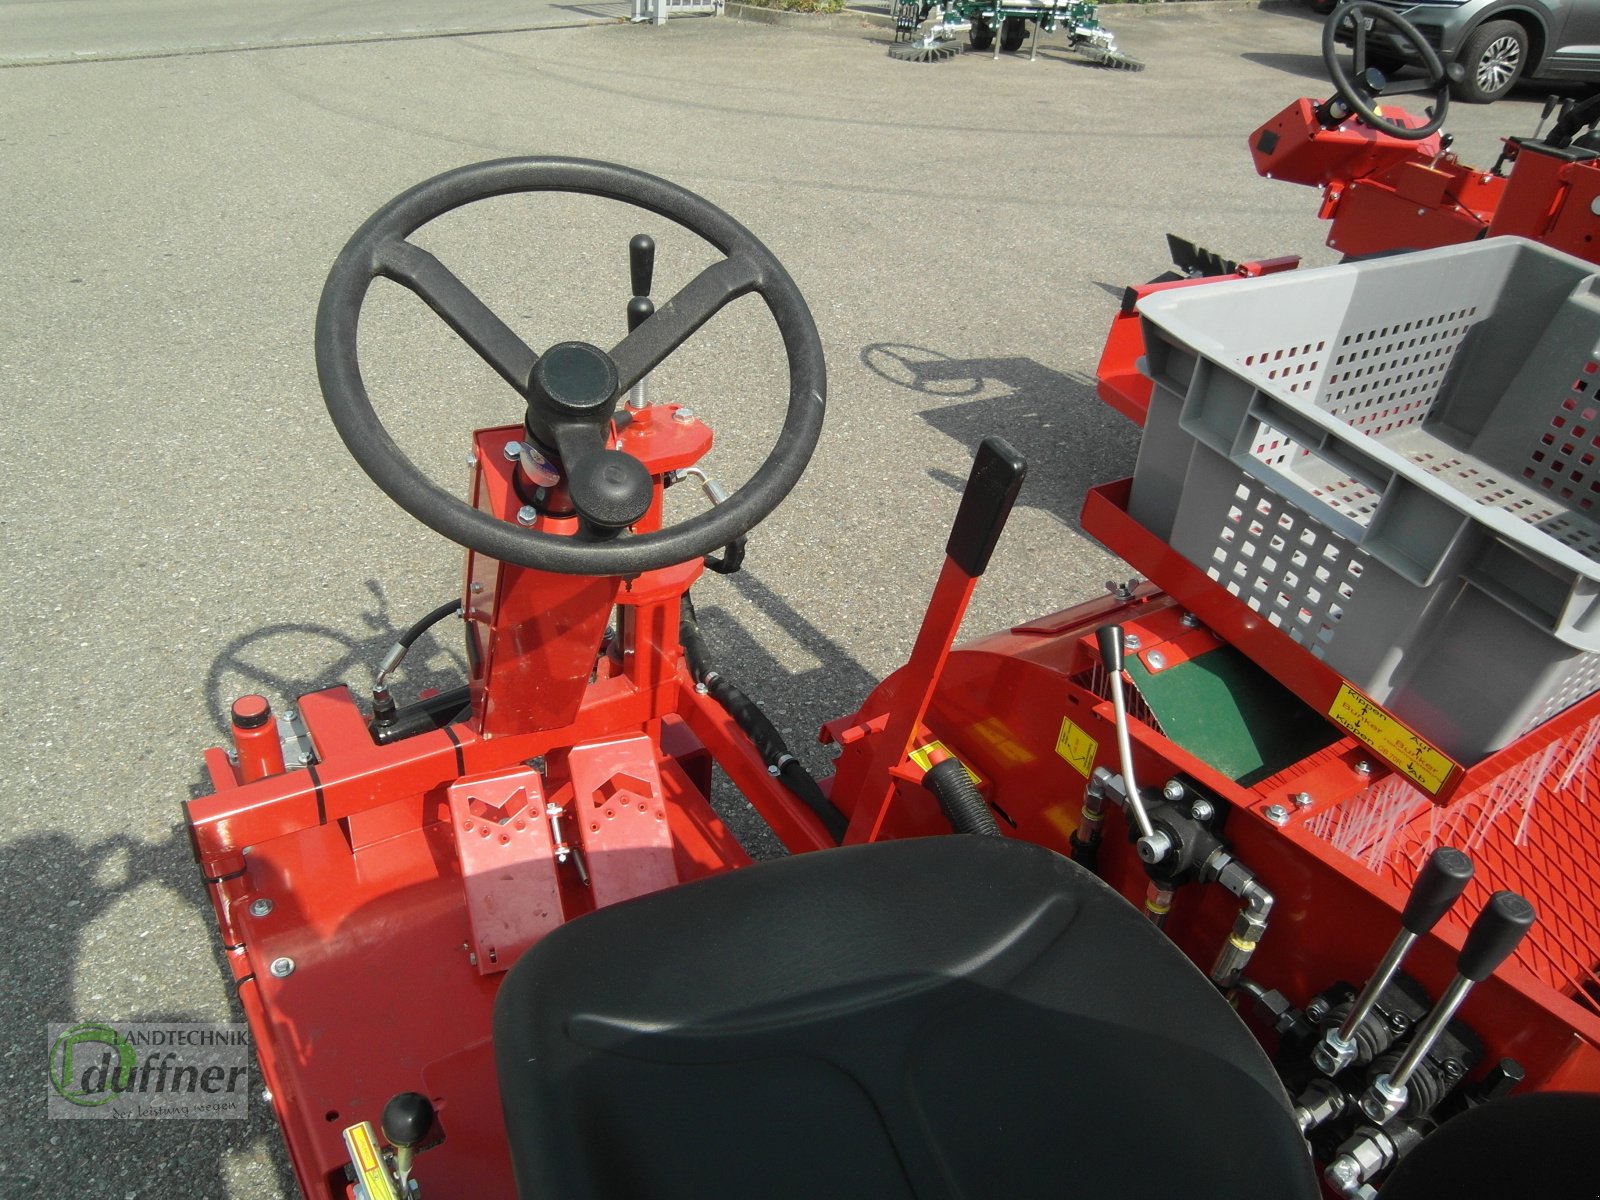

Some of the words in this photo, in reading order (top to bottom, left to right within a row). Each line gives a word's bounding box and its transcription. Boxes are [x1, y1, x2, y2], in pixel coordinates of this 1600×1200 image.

[1342, 702, 1382, 733] Bunker
[1347, 689, 1387, 721] Kippen
[1335, 713, 1374, 746] Kippen
[1409, 736, 1431, 753] Auf
[1394, 739, 1439, 774] Bunker
[1408, 769, 1426, 783] Ab
